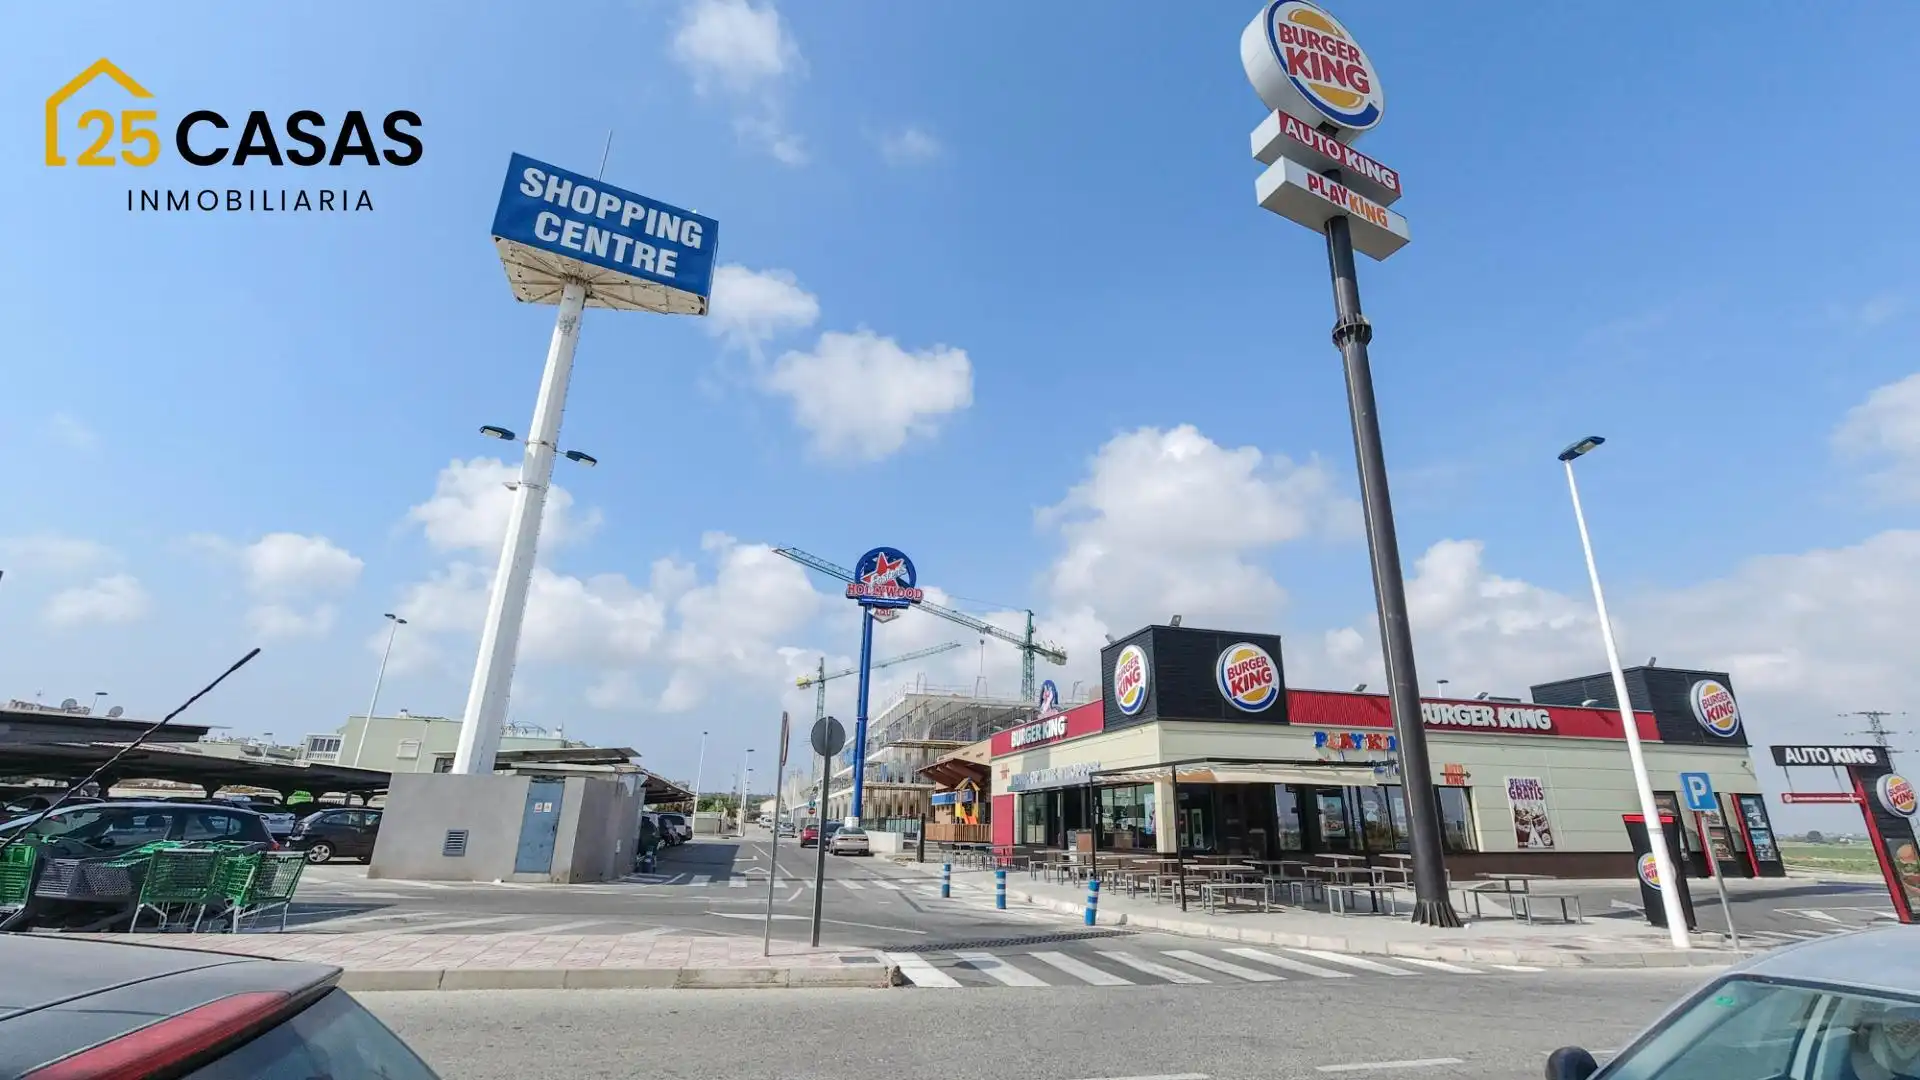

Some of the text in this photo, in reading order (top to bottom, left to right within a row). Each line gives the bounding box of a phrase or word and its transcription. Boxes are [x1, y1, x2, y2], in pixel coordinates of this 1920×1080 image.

[1279, 22, 1362, 65] BURGER
[1285, 47, 1370, 95] KING
[1285, 118, 1396, 190] AUTO KING
[520, 167, 703, 249] SHOPPING
[534, 211, 678, 278] CENTRE
[847, 583, 923, 600] HOLLYWOOD
[1117, 665, 1141, 698] KING
[1227, 656, 1268, 681] BURGER
[1231, 667, 1273, 697] KING
[1702, 691, 1730, 709] BURGER
[1706, 701, 1734, 723] KING
[1011, 716, 1067, 748] BURGER KING
[1498, 707, 1552, 730] KING
[1785, 747, 1877, 764] AUTO KING
[1508, 785, 1544, 801] GRATIS
[1687, 776, 1707, 806] P
[1893, 790, 1914, 806] KING
